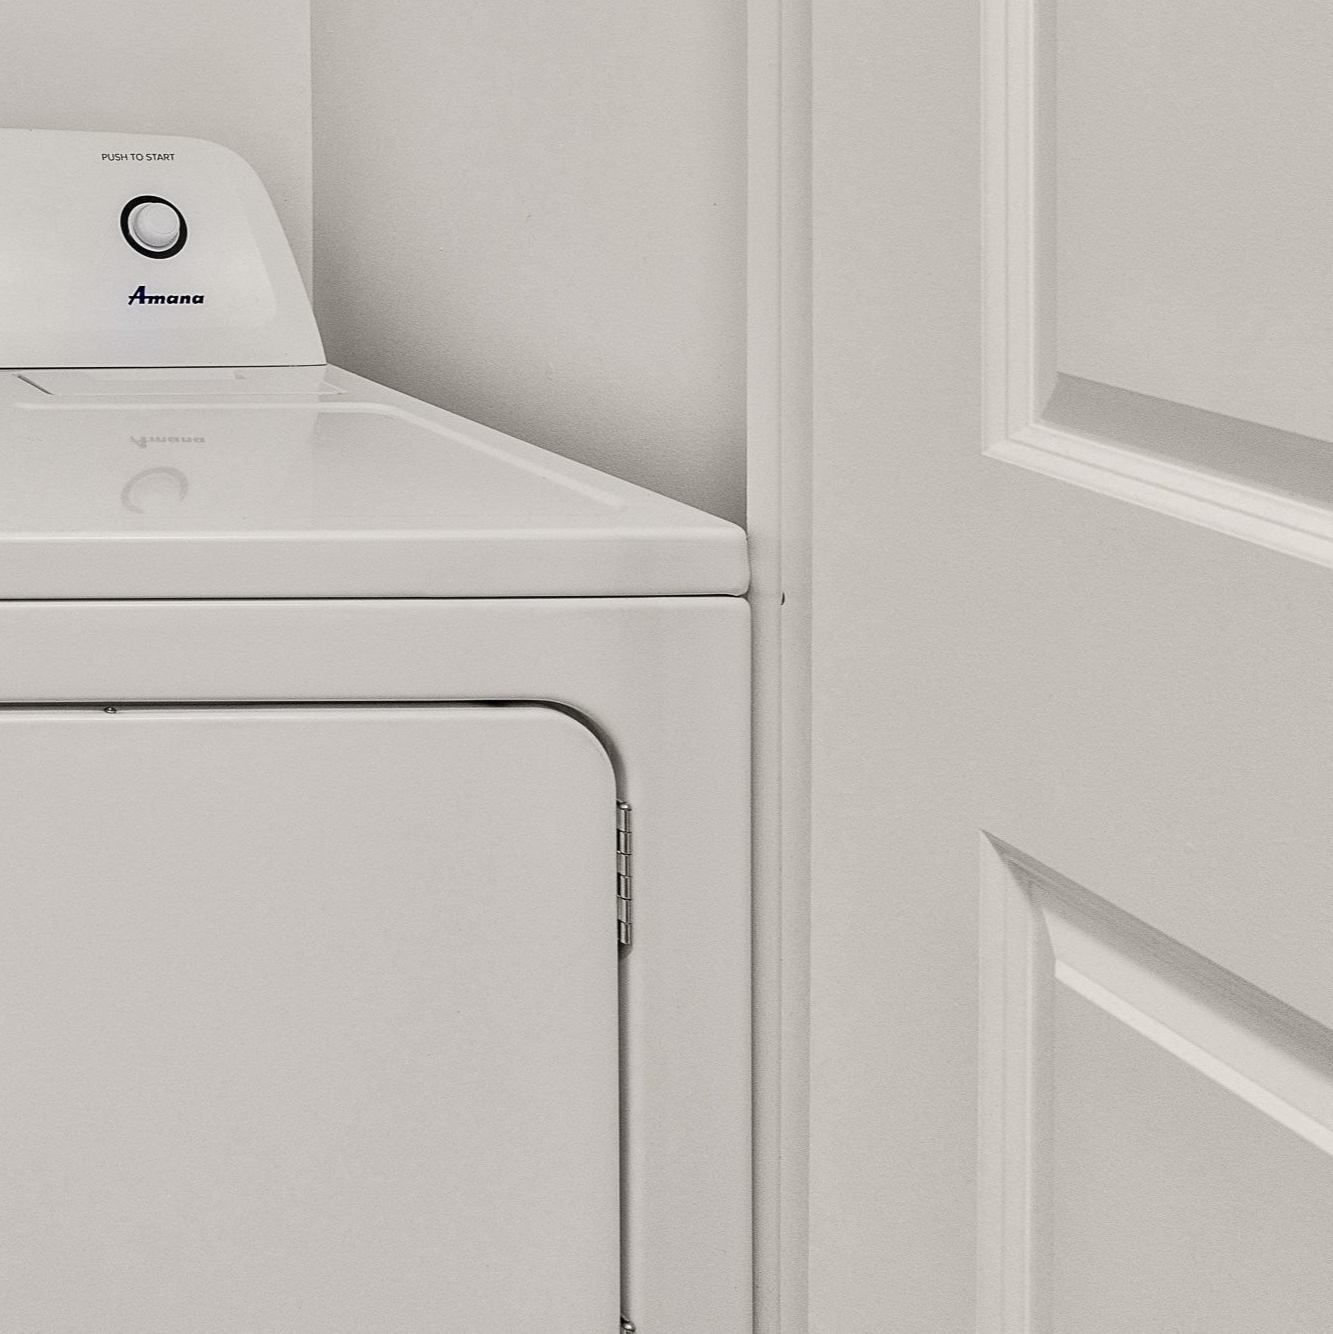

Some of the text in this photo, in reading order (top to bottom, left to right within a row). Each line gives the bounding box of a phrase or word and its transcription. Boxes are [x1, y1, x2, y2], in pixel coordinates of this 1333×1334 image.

[101, 153, 175, 161] PUSH TO START
[128, 285, 205, 306] Amana
